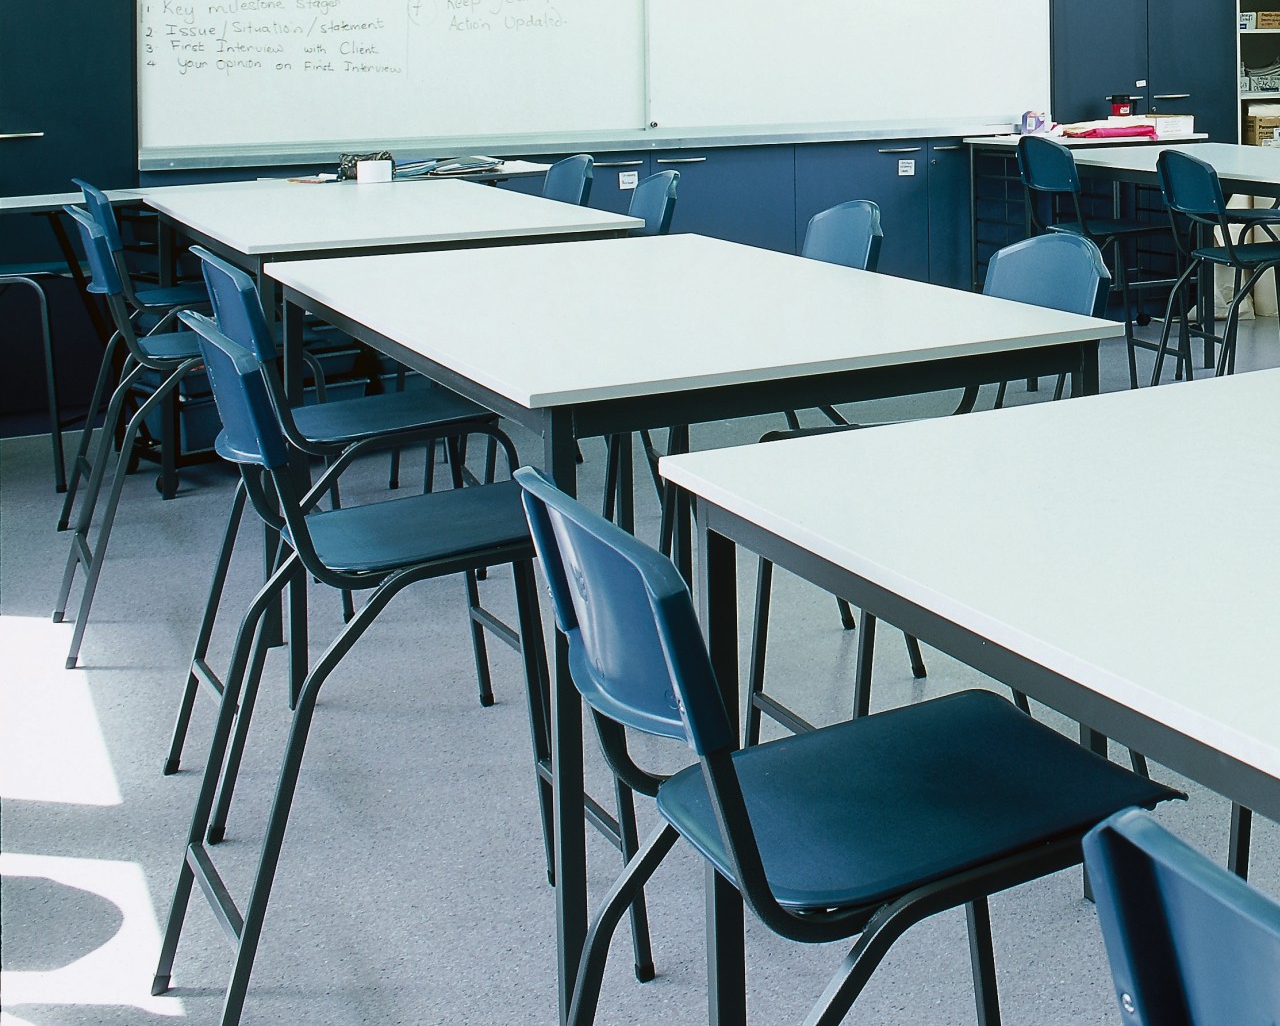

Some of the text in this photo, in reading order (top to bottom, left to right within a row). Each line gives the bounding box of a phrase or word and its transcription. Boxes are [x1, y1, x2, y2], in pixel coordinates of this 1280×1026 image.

[162, 0, 196, 25] Key
[448, 14, 491, 32] Action
[170, 39, 206, 53] First
[215, 38, 284, 54] Interview
[303, 44, 328, 55] with
[339, 40, 380, 56] Client
[274, 60, 293, 71] on
[303, 60, 336, 72] First
[343, 59, 402, 74] Interview
